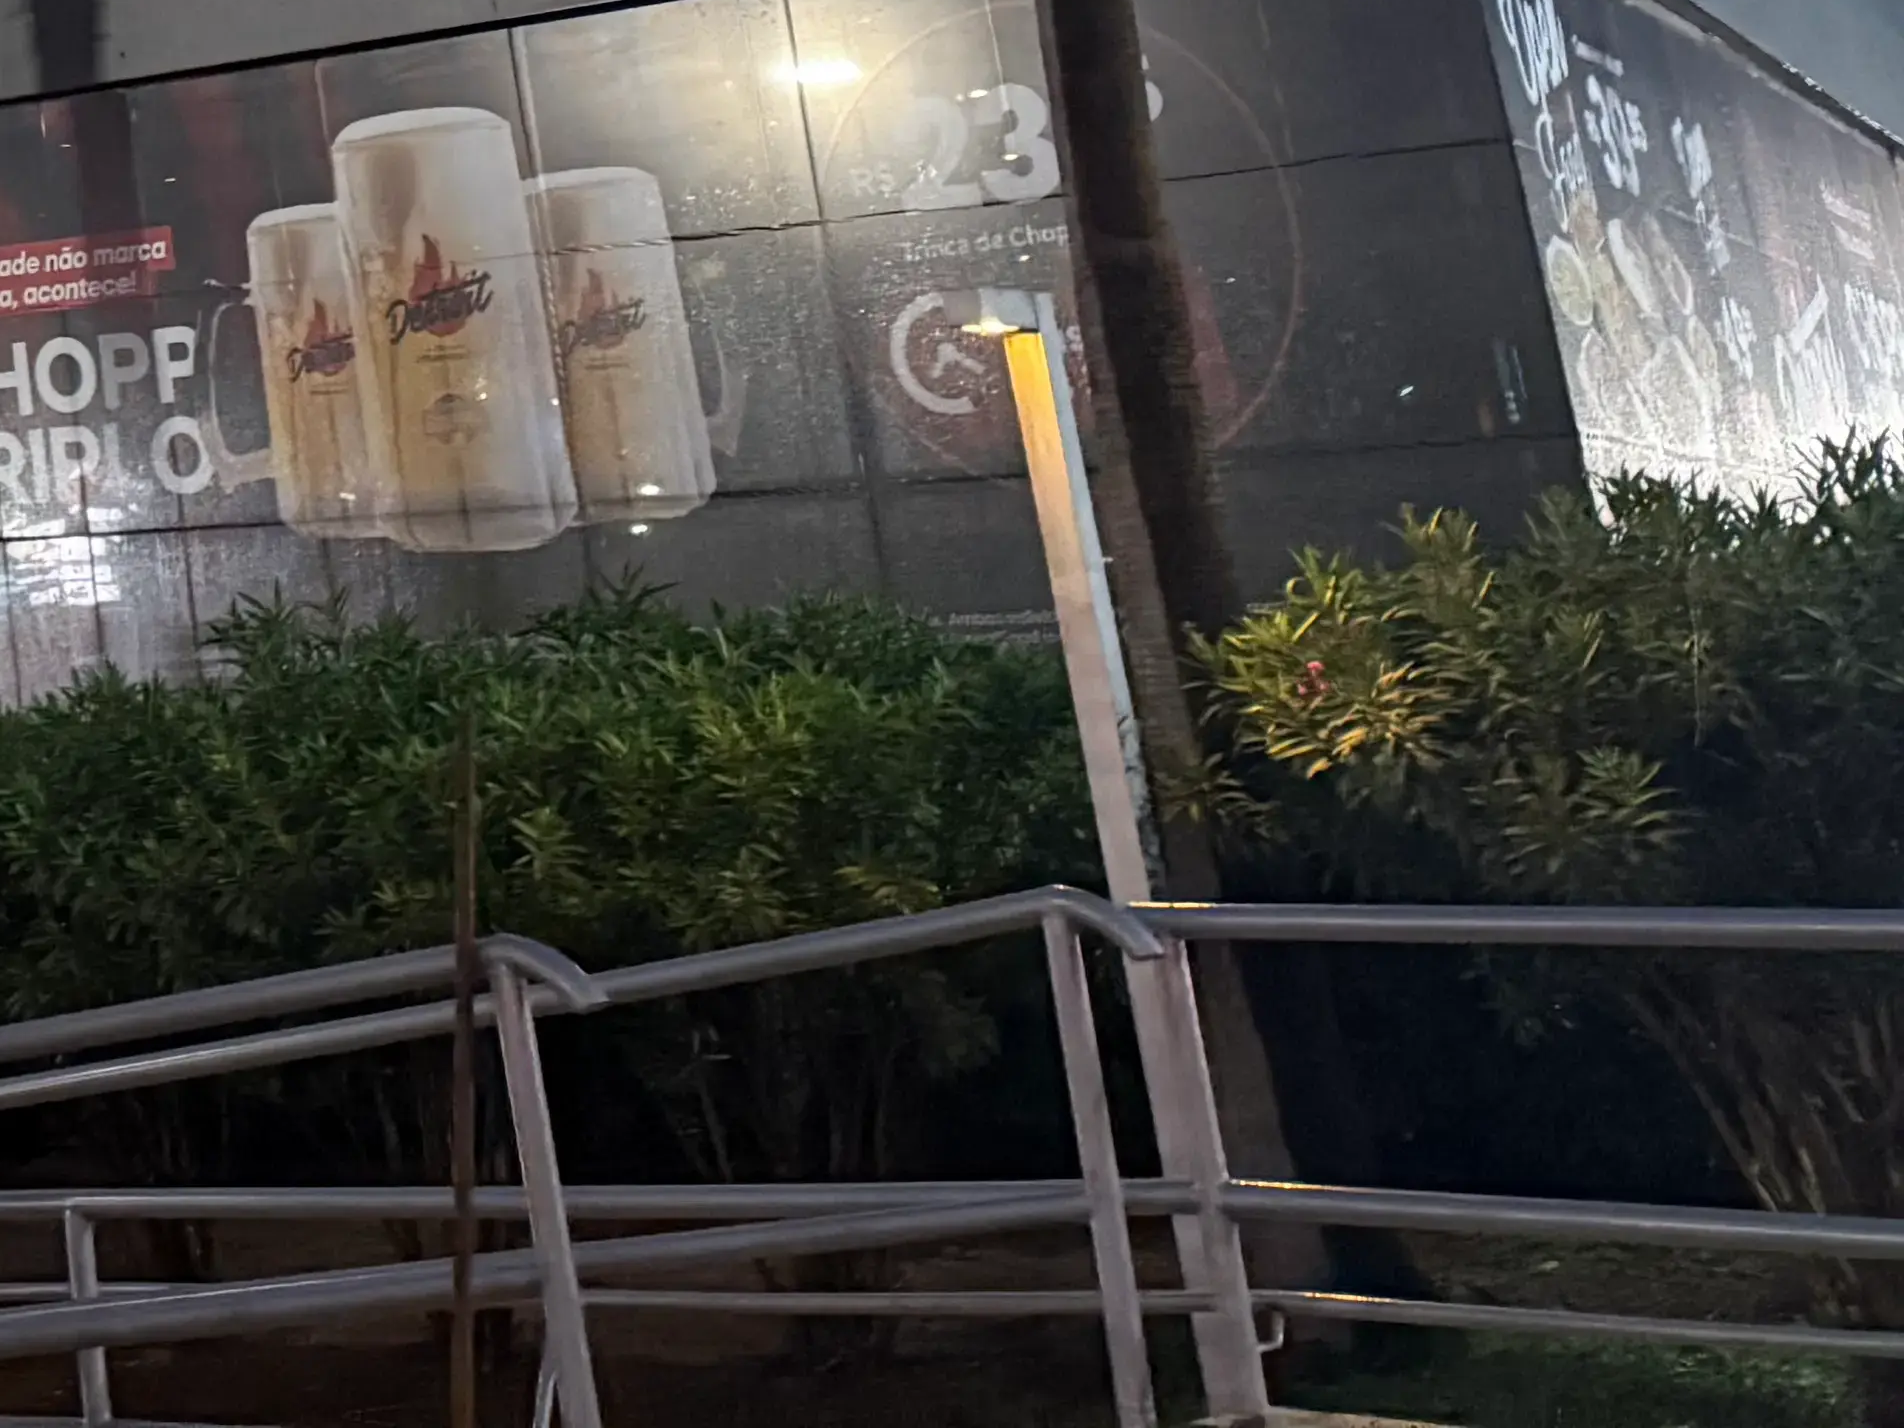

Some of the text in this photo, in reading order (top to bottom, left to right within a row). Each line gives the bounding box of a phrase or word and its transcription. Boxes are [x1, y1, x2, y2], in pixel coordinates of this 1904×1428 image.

[45, 247, 88, 272] não
[94, 239, 167, 265] marca
[23, 271, 136, 304] acontece!
